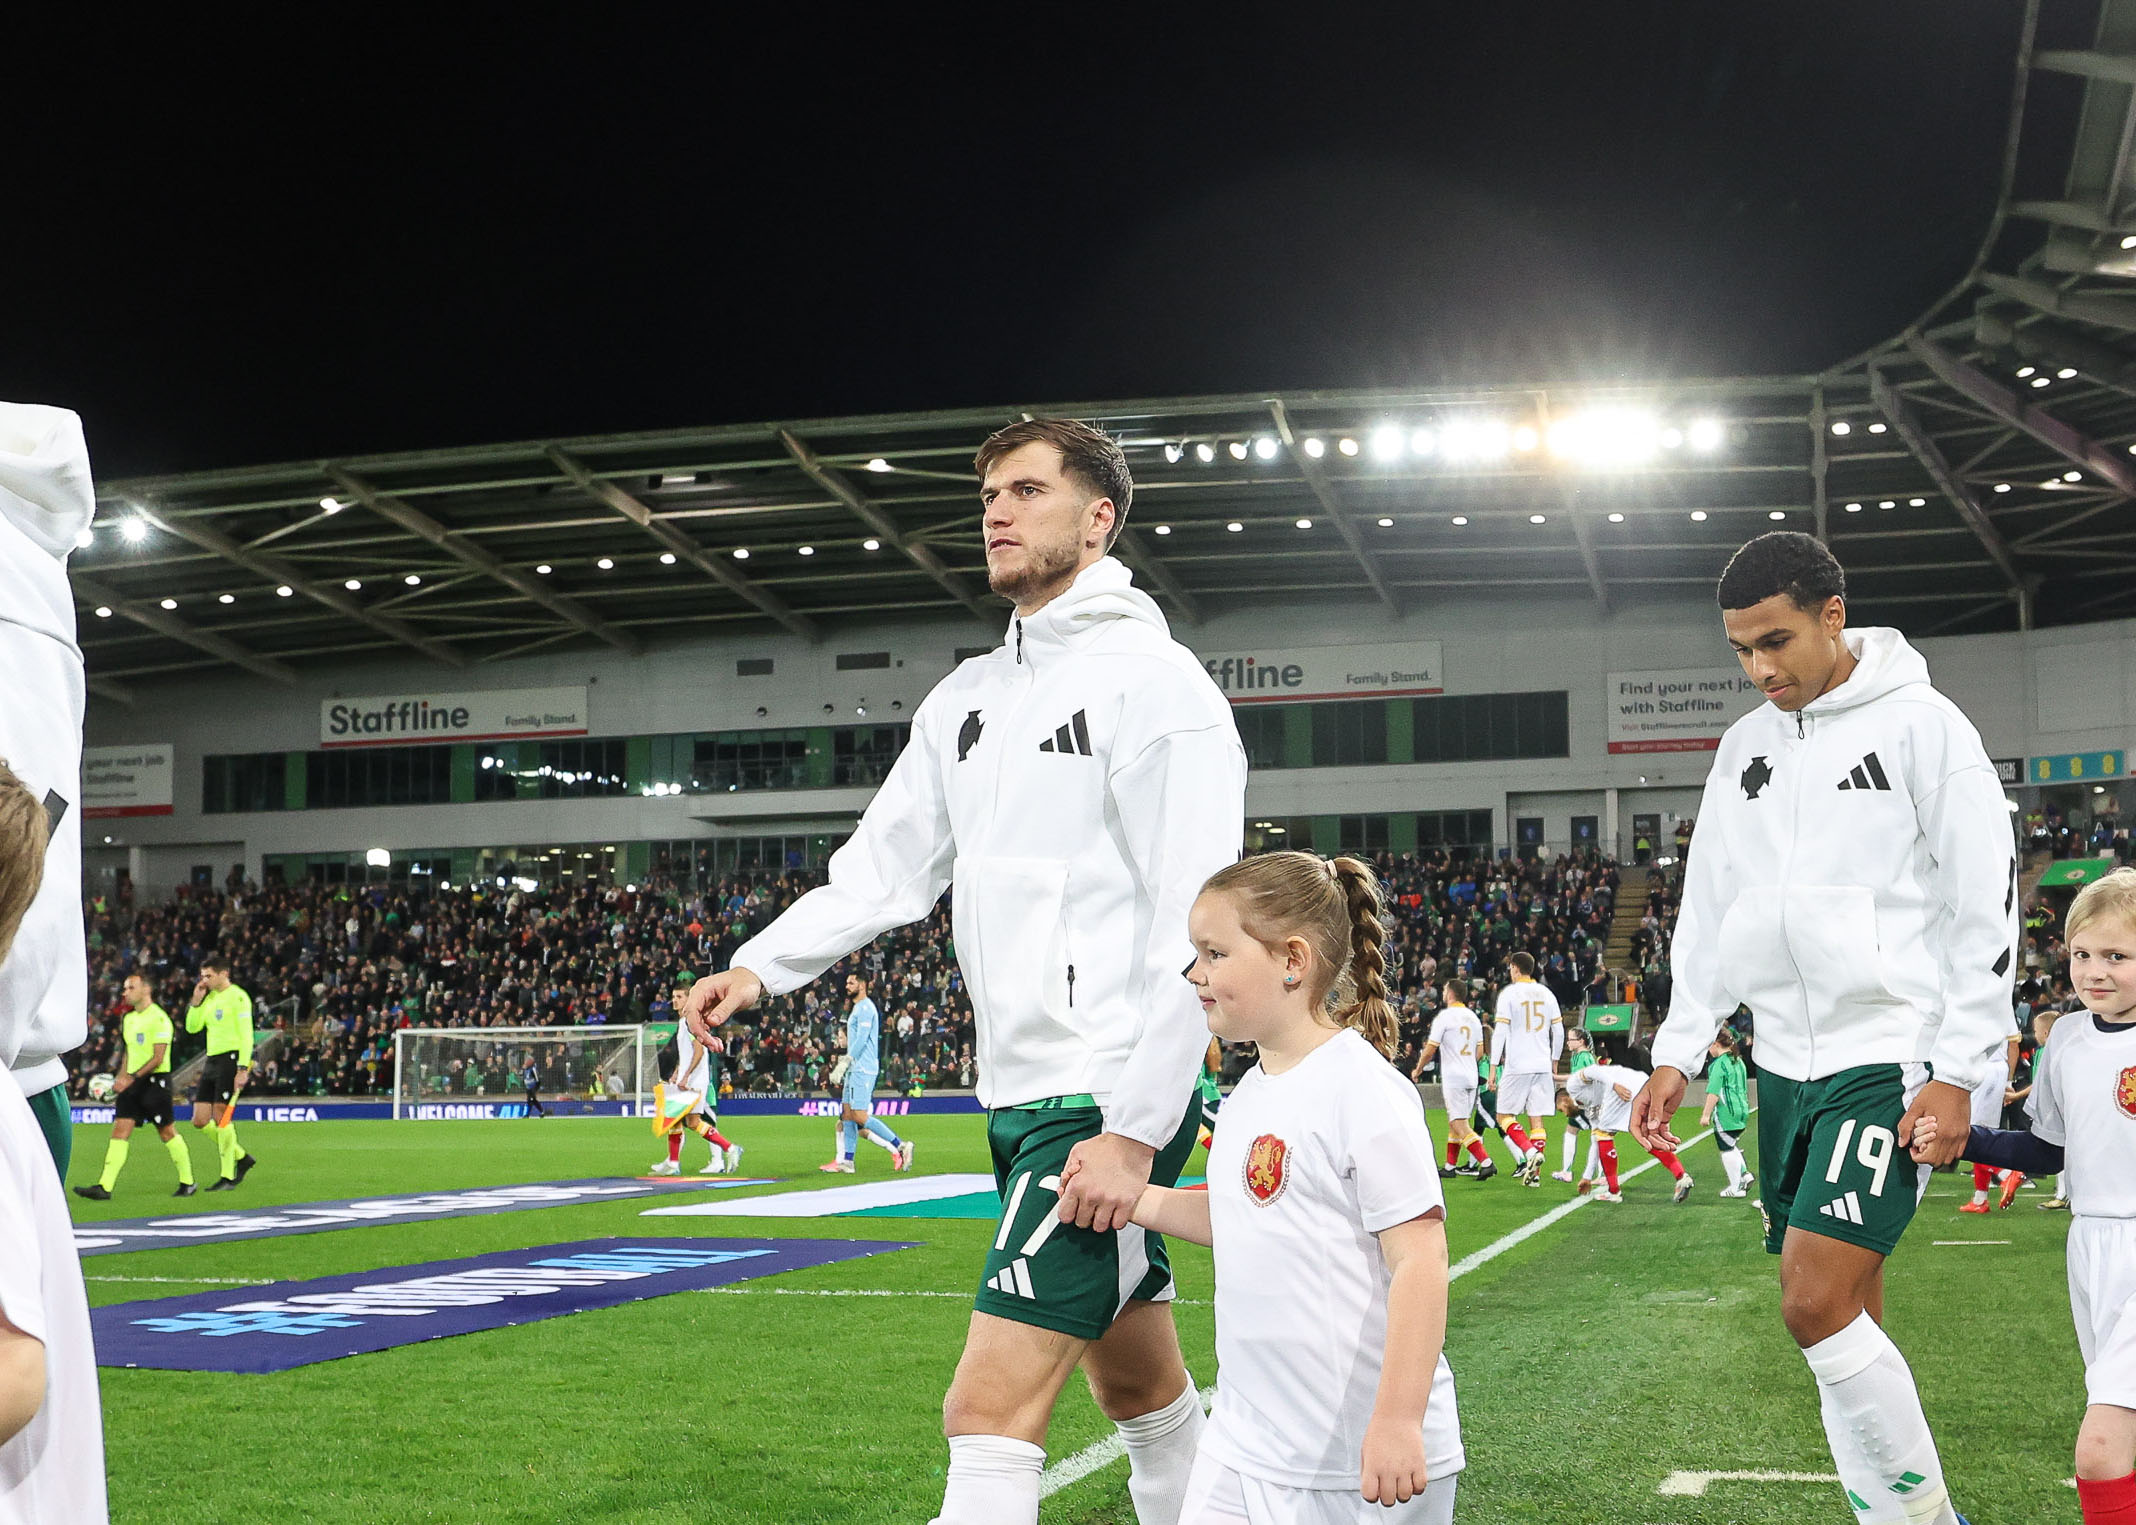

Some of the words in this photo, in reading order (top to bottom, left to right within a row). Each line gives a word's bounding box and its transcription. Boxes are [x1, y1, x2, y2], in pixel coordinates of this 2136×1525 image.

[1206, 657, 1303, 690] ffline
[1346, 672, 1388, 686] Family
[1391, 670, 1432, 682] Stand.
[1620, 681, 1653, 695] Find
[1658, 683, 1693, 698] your
[1699, 680, 1733, 692] next
[1738, 678, 1757, 693] jo
[330, 701, 469, 735] Staffline
[505, 714, 541, 728] Family
[1620, 701, 1654, 715] with
[1659, 699, 1724, 714] Staffline
[1521, 1000, 1545, 1033] 15
[1460, 1026, 1472, 1056] 2
[1825, 1119, 1895, 1197] 19
[73, 1186, 655, 1238] LEAGUE
[995, 1171, 1062, 1257] 17
[128, 1248, 779, 1337] #FOOTBALL
